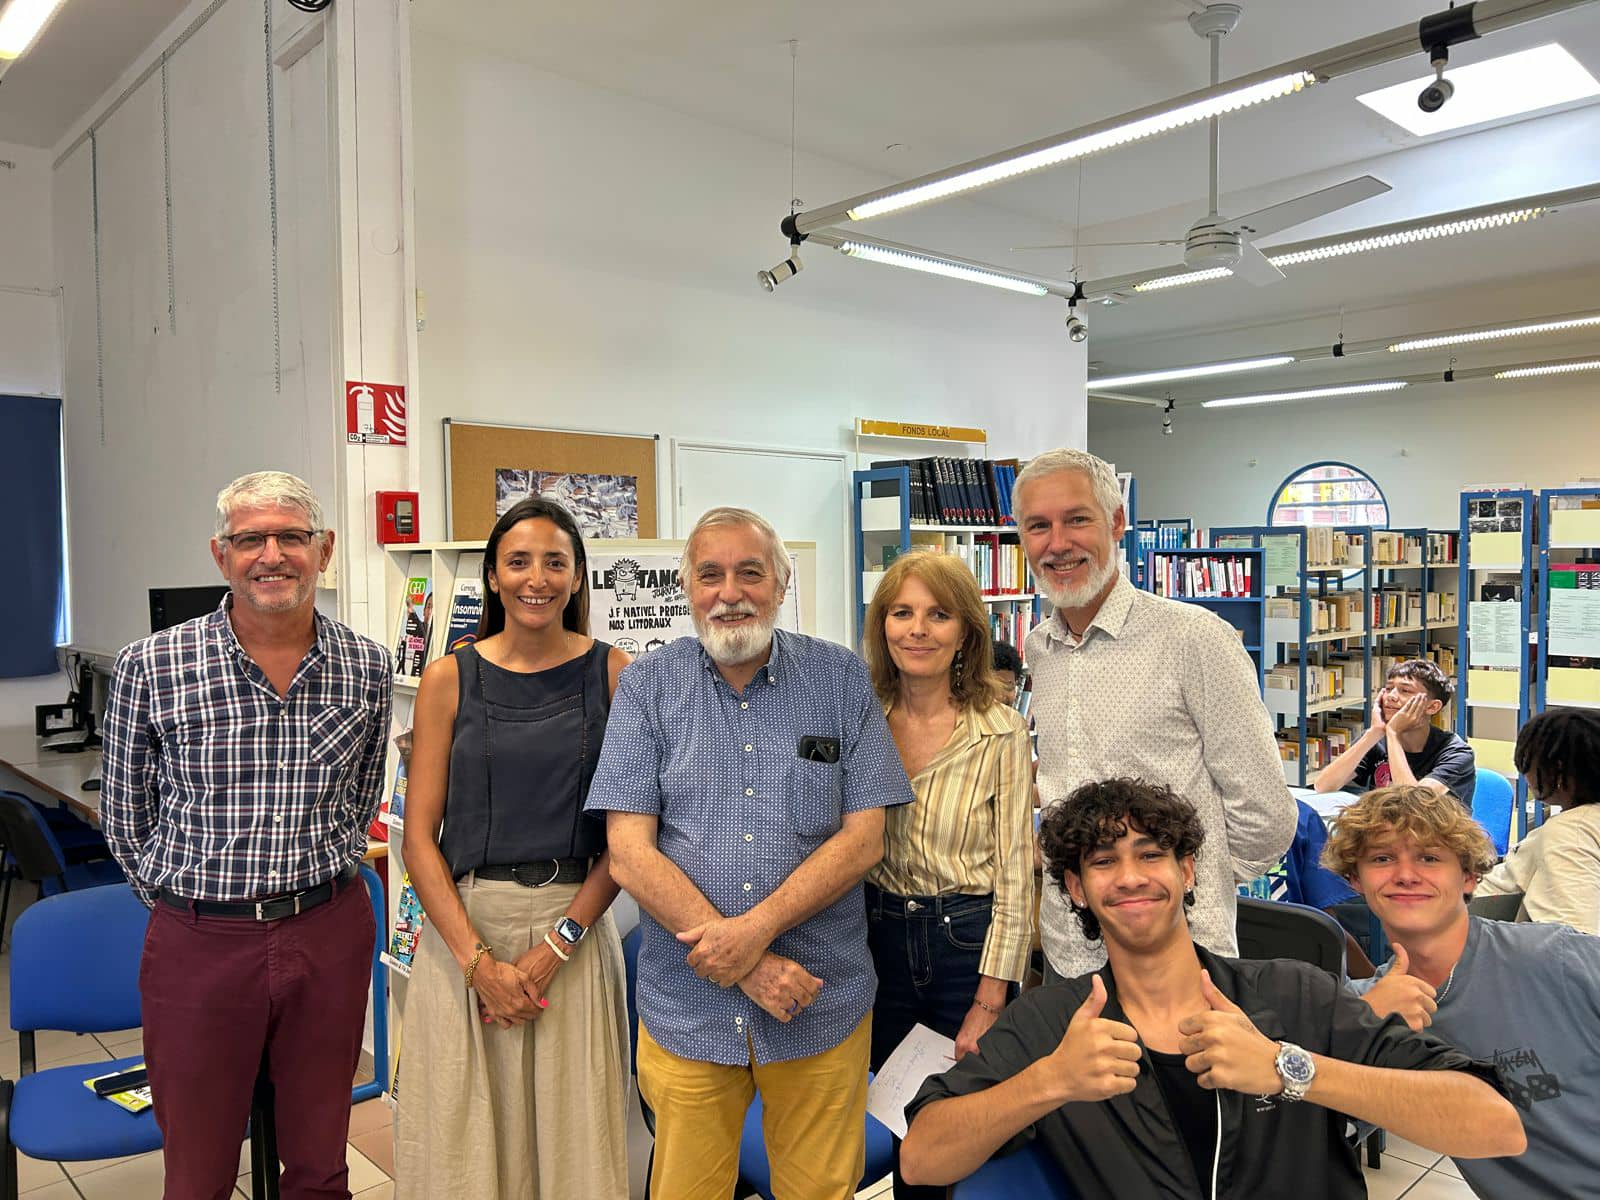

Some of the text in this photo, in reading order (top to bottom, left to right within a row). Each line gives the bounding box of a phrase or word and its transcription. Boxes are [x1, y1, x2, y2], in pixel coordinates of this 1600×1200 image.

[902, 426, 951, 438] FONDS LOCAL
[608, 617, 672, 631] NOS LITTORAUX
